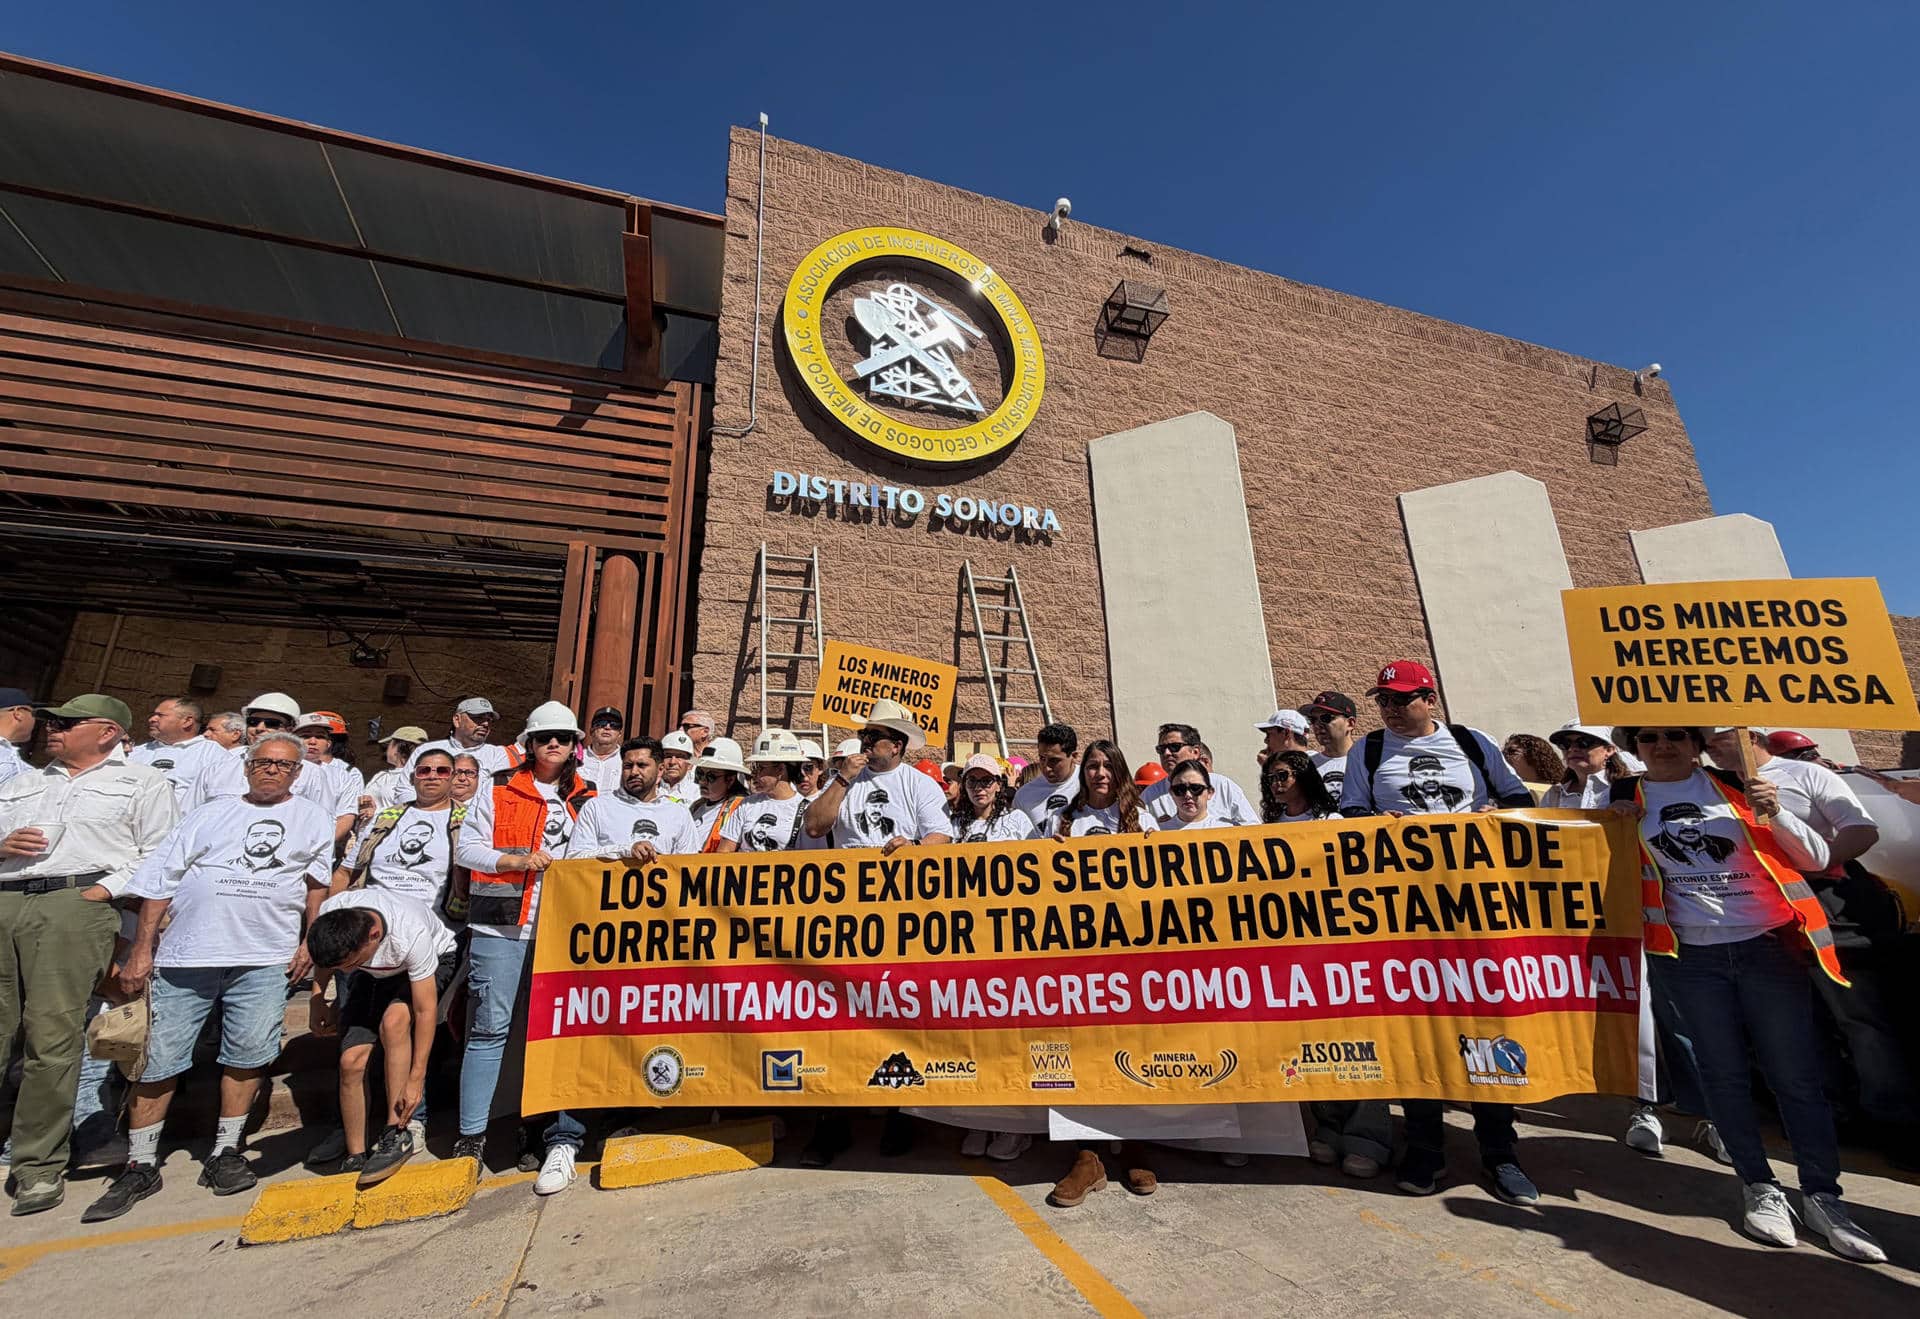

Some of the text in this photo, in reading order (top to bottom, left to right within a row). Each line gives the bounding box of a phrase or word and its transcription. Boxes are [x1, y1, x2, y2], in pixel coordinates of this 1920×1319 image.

[862, 236, 885, 250] DE
[887, 235, 979, 275] INGENIEROS
[796, 240, 861, 306] ASOCIACIÓN
[979, 271, 999, 294] DE
[996, 293, 1028, 334] MINAS
[991, 338, 1038, 438] METALURGISTAS
[858, 416, 881, 434] DE
[982, 431, 994, 445] Y
[886, 429, 978, 455] GEÓLOGOS
[773, 470, 1061, 531] DISTRITO SONORA
[1600, 599, 1848, 632] LOS MINEROS
[1614, 636, 1849, 667] MERECEMOS
[838, 654, 941, 690] LOS MINEROS
[837, 676, 933, 710] MERECEMOS
[1591, 673, 1895, 705] VOLVER A CASA
[220, 878, 250, 886] ANTONIO
[600, 822, 1563, 911] LOS MINEROS EXIGIMOS SEGURIDAD. ¡BASTA DE
[569, 881, 1607, 965] CORRER PELIGRO POR TRABAJAR HONESTAMENTE!
[552, 954, 1638, 1036] ¡NO PERMITAMOS MÁS MASACRES COMO LA DE CONCORDIA!
[1030, 1043, 1070, 1051] MUJERES
[1153, 1053, 1197, 1062] MINERIA
[1301, 1041, 1378, 1063] ASORM
[924, 1061, 977, 1073] AMSAC
[1141, 1064, 1213, 1078] SIGLO XXI
